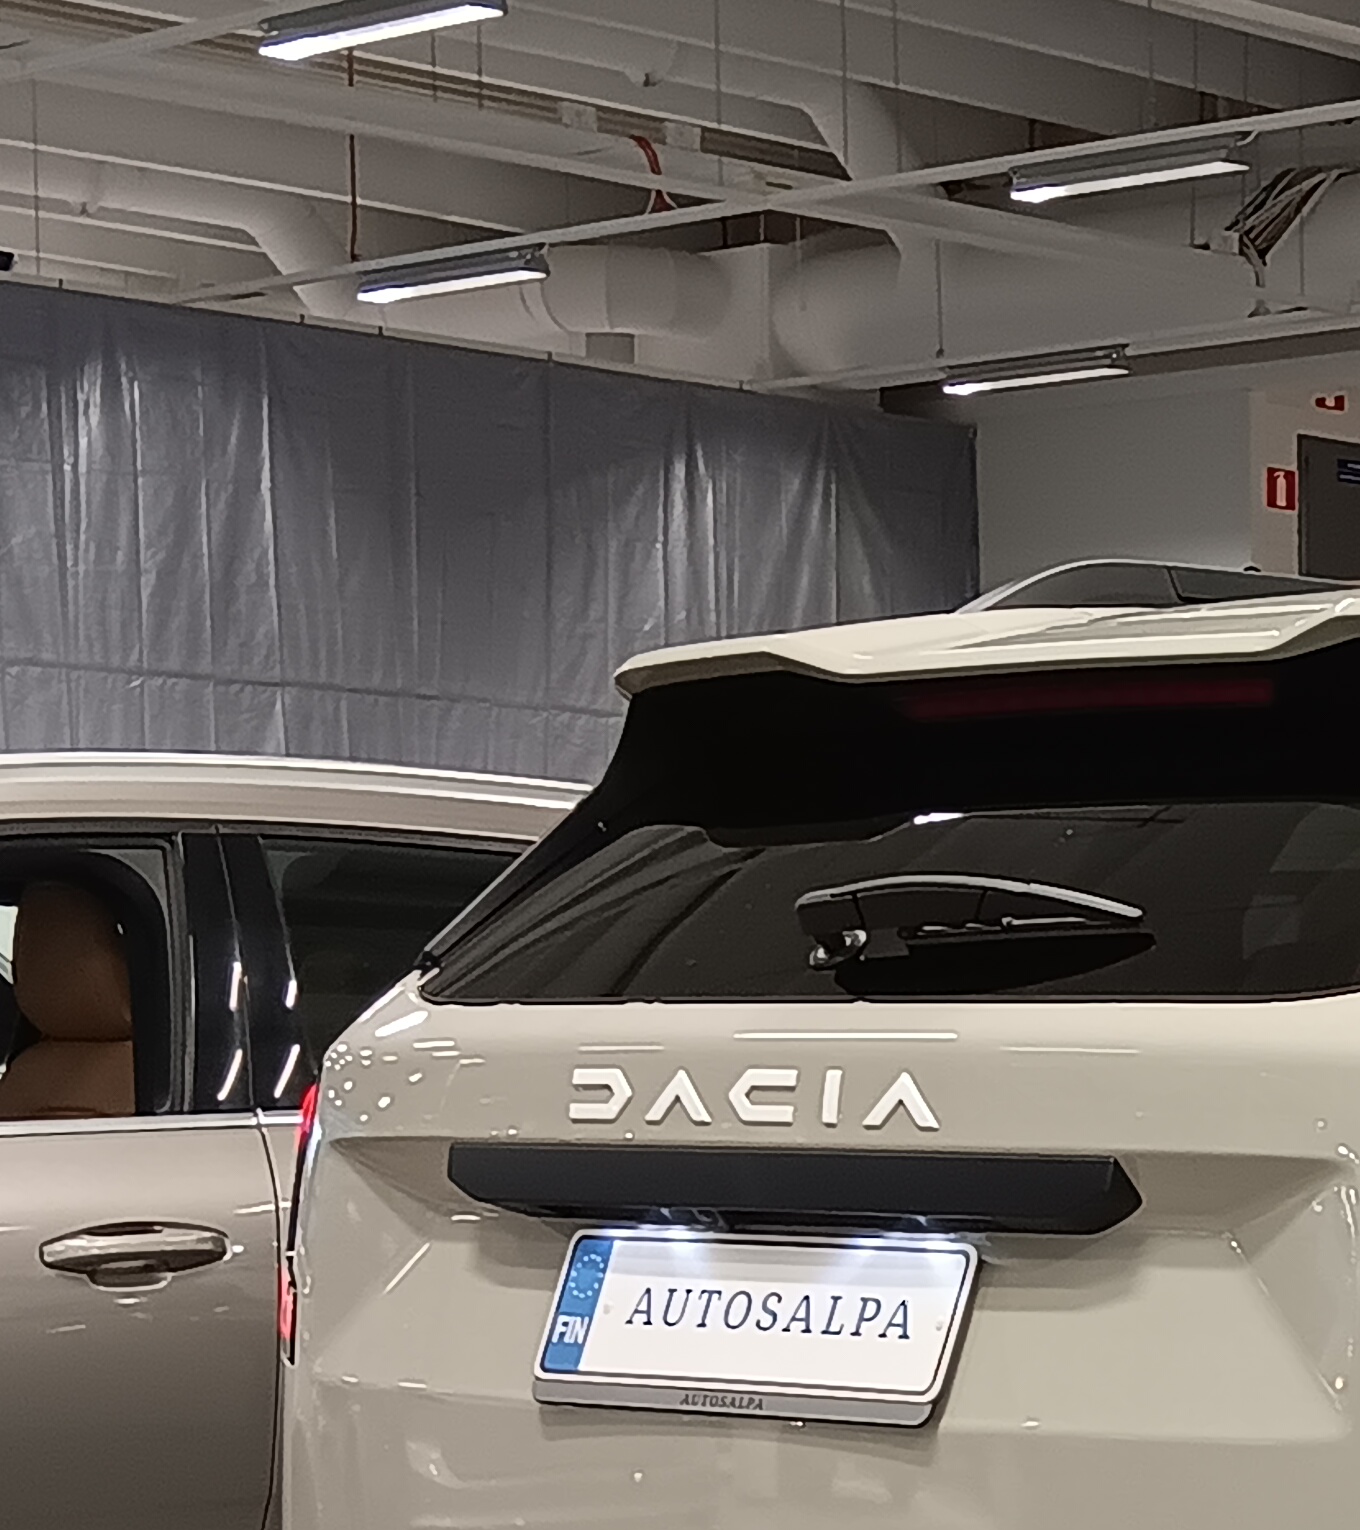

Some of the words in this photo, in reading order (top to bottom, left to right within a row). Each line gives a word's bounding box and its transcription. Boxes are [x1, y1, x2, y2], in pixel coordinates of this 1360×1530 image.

[568, 1066, 940, 1131] DACIA
[550, 1313, 590, 1345] FIN
[624, 1286, 911, 1340] AUTOSALPA
[678, 1393, 764, 1411] AUTOSALPA
